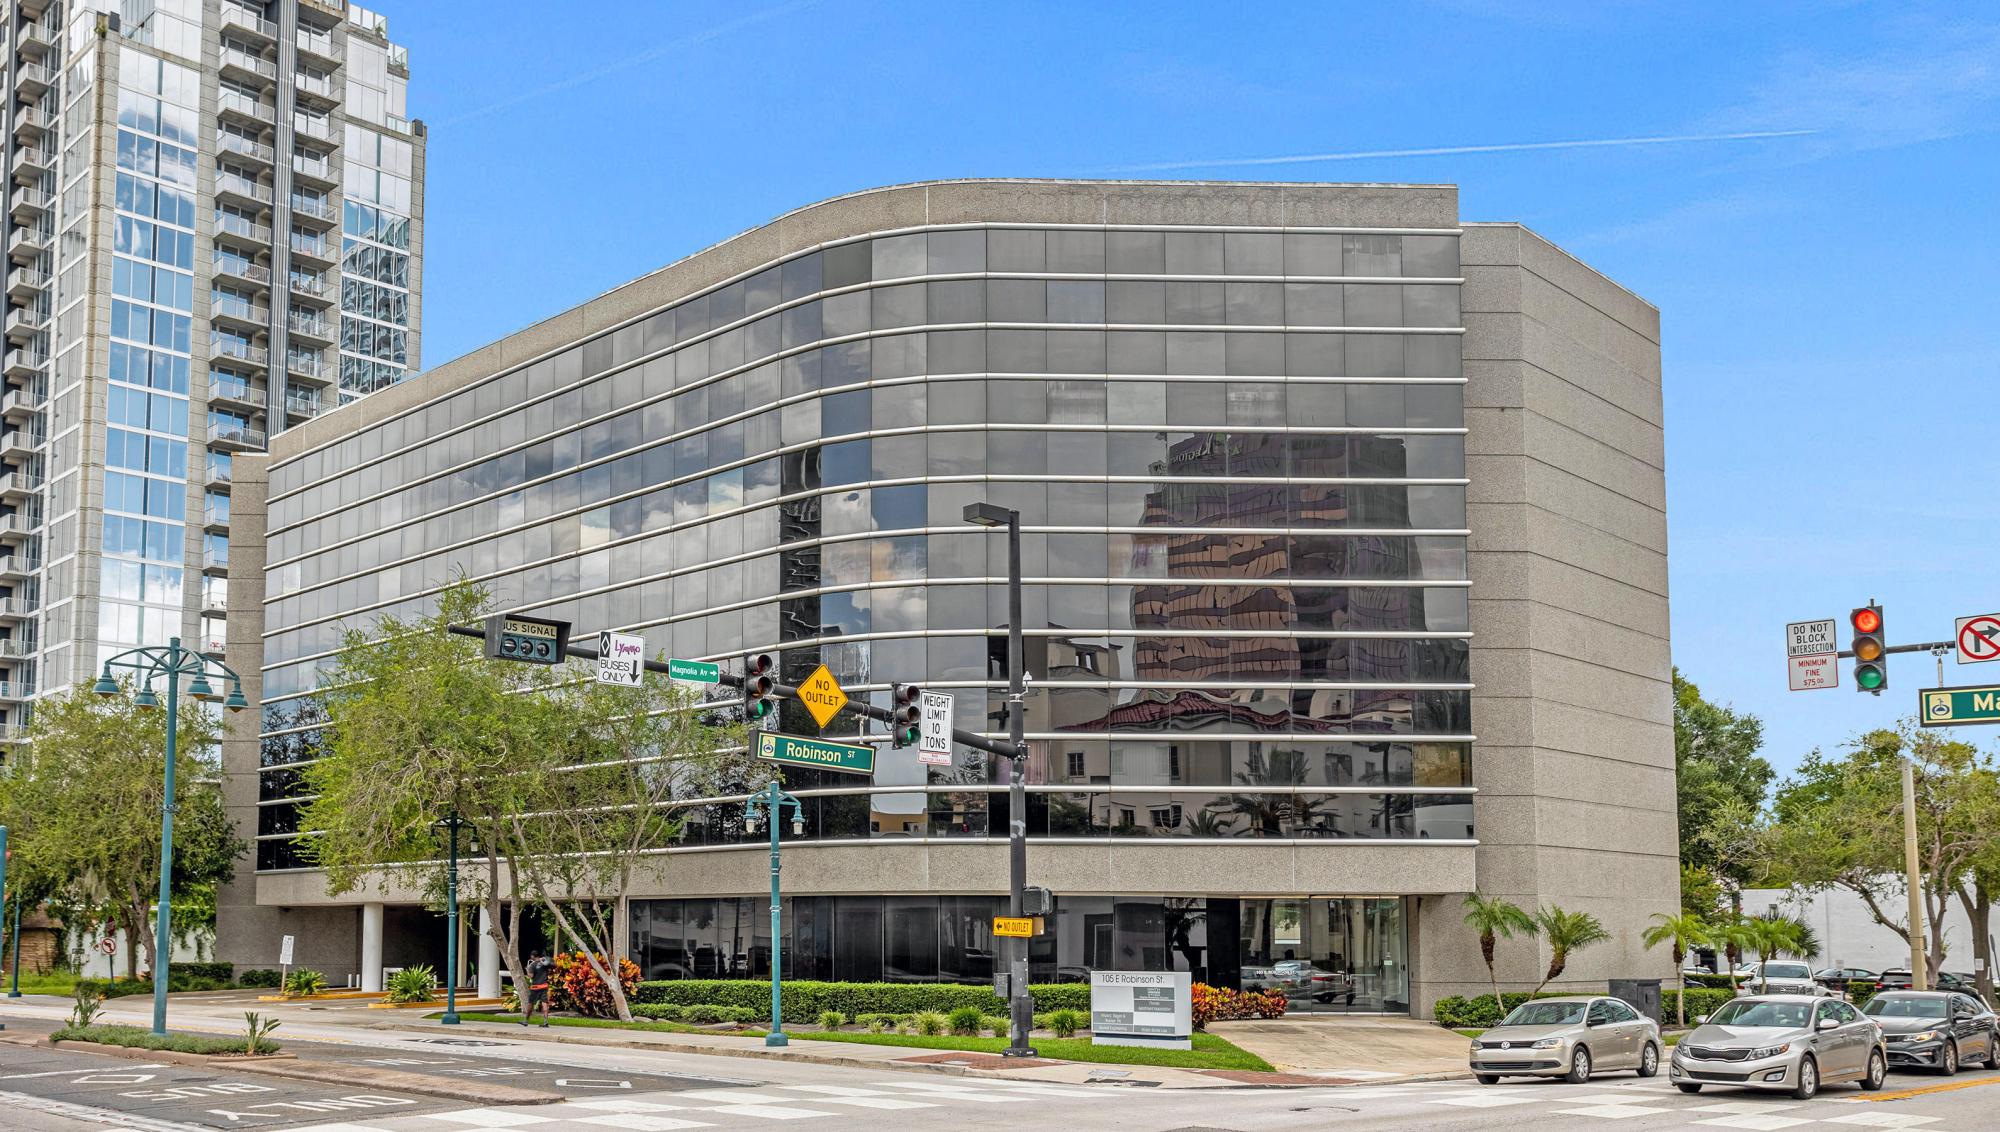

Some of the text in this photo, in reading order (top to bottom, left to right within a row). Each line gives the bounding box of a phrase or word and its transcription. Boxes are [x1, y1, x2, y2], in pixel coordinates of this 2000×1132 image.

[521, 624, 556, 637] SIGNAL
[1793, 622, 1828, 635] DO NOT
[1796, 633, 1826, 644] BLOCK
[1790, 642, 1834, 655] INTERSECTION
[600, 659, 630, 672] BUSES
[1798, 658, 1827, 667] MINIMUM
[602, 671, 626, 682] ONLY
[671, 664, 698, 676] Magnolia
[1805, 668, 1820, 677] FINE
[815, 679, 830, 691] NO
[805, 691, 839, 706] OUTLET
[924, 695, 950, 708] WEIGHT
[927, 709, 946, 721] LIMIT
[932, 722, 941, 735] 10
[925, 736, 946, 749] TONS
[786, 741, 856, 763] Robinson ST
[1003, 921, 1029, 933] NO OUTLET
[1101, 974, 1165, 984] 105 E Robinson St.
[117, 1083, 278, 1101] BUS
[206, 1095, 419, 1121] ONLY
